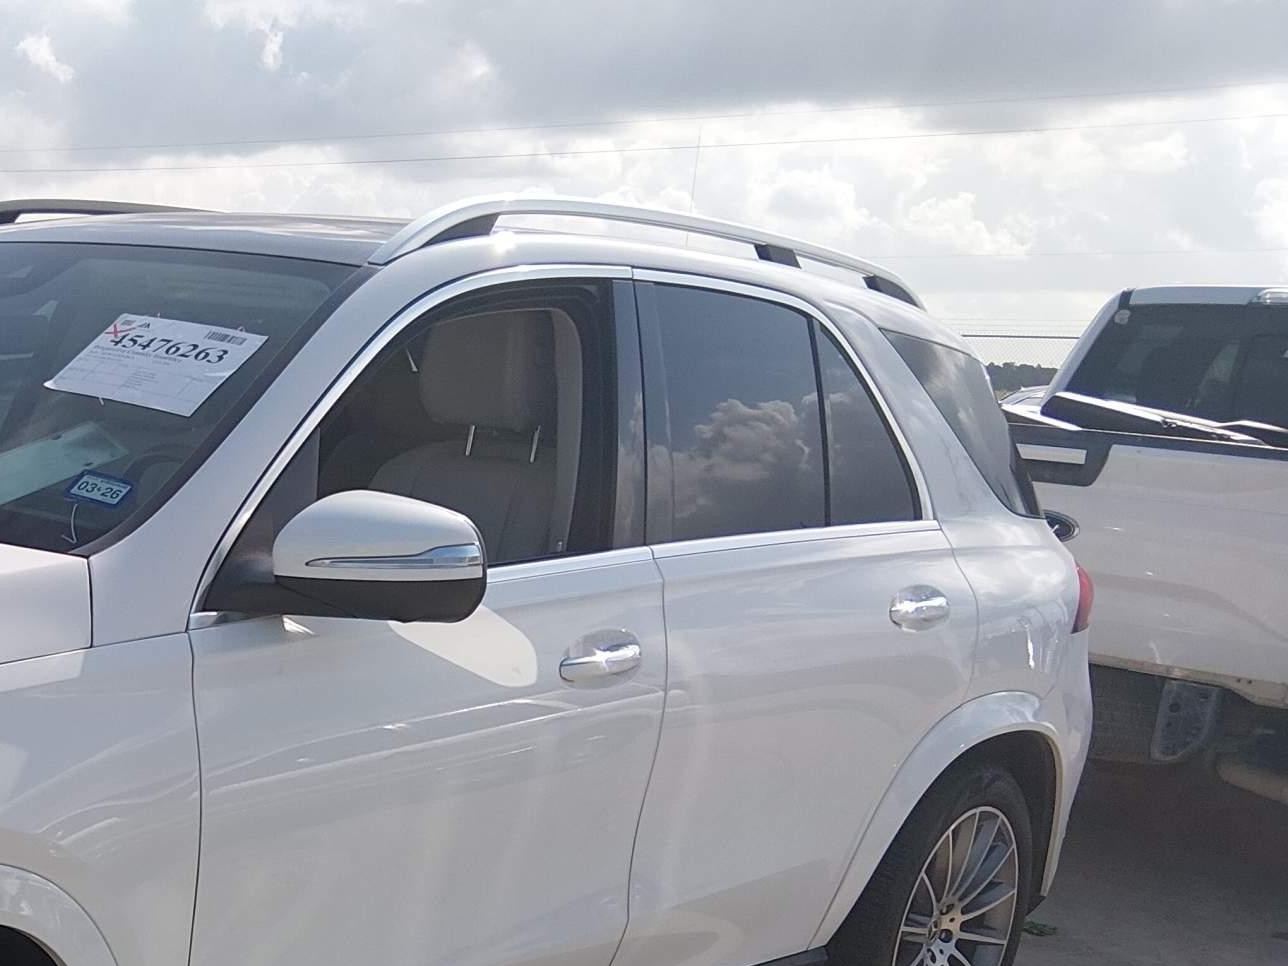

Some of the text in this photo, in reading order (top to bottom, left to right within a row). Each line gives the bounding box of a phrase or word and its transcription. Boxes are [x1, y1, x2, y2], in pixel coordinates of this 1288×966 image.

[110, 333, 229, 364] 45476263
[77, 481, 98, 493] 03
[100, 487, 123, 499] 26
